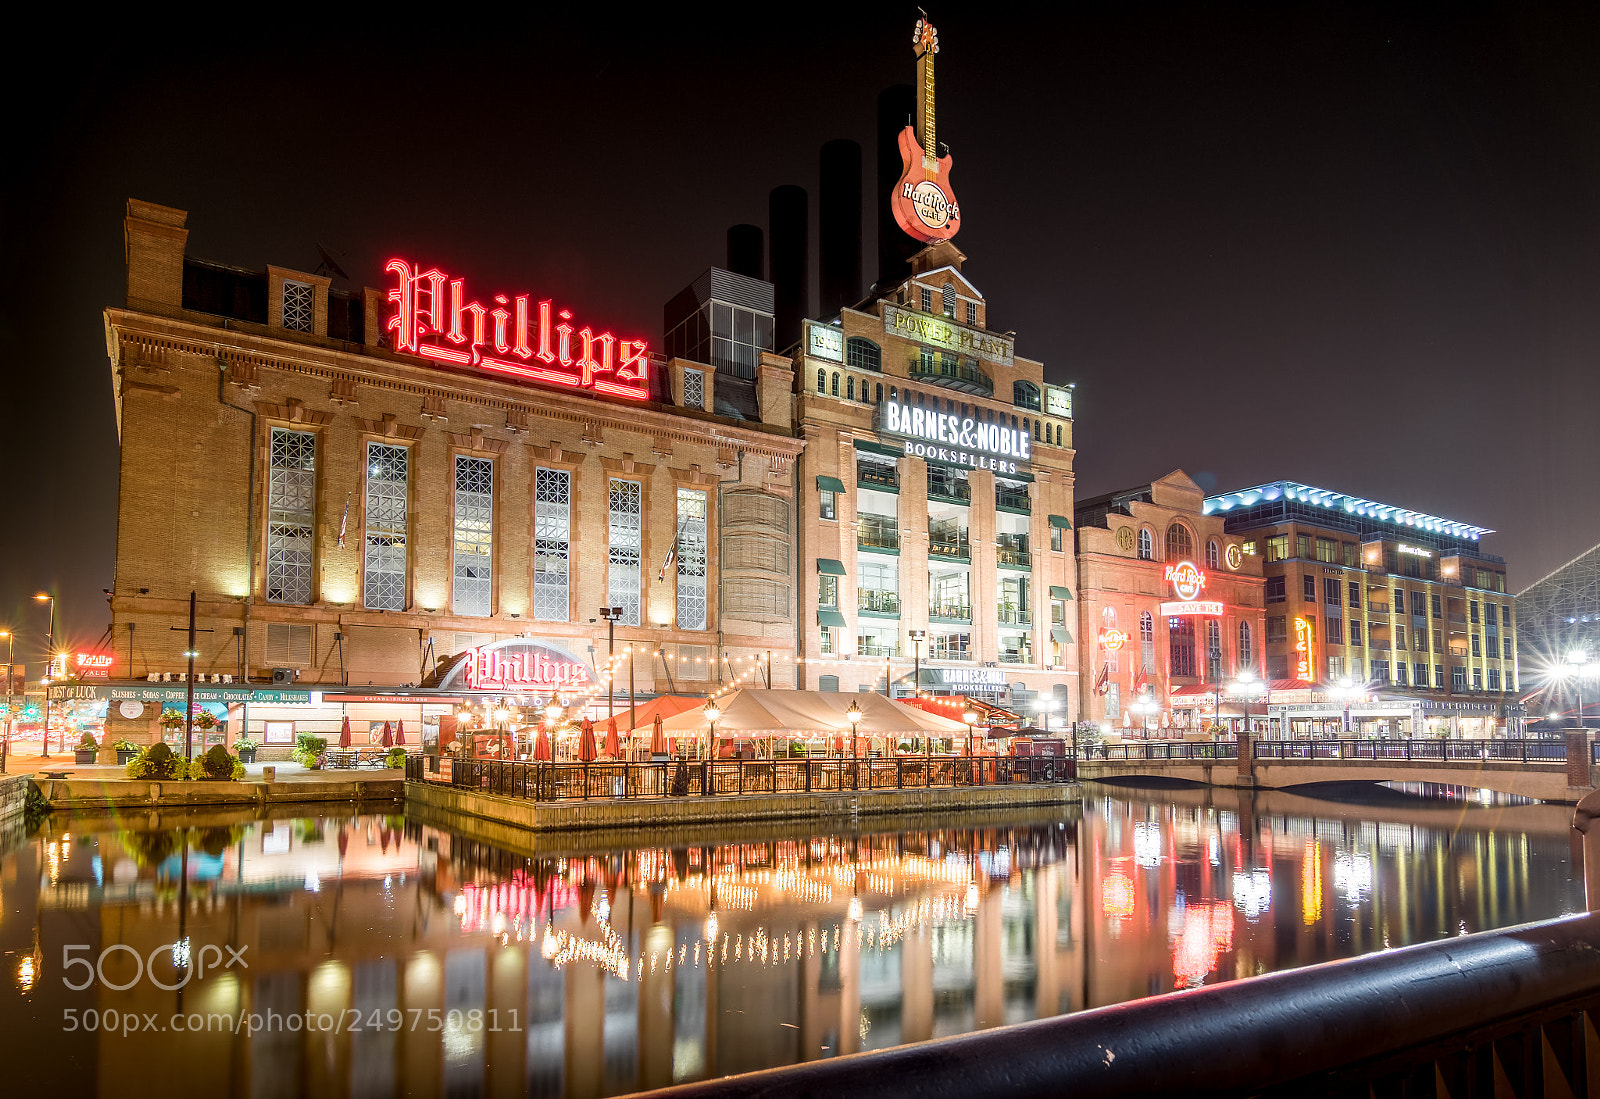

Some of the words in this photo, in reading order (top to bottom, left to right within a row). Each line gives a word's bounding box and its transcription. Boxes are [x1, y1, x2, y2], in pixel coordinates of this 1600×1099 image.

[903, 183, 933, 206] Hard
[932, 193, 960, 220] Rock
[386, 258, 649, 387] Phillips
[895, 312, 952, 344] POWER
[960, 330, 1009, 359] PLANT
[905, 441, 1017, 474] BOOKSELLERS
[1165, 565, 1187, 582] Hard
[1186, 569, 1206, 588] Rock
[1179, 604, 1202, 613] SAVE
[1205, 604, 1217, 613] THE
[466, 647, 589, 691] Phillips
[76, 685, 96, 699] LUCK
[111, 689, 136, 699] SLUSHIES
[142, 690, 160, 699] SODAS
[165, 690, 185, 699] COFFEE
[201, 691, 217, 699] CREAM
[223, 691, 252, 700] CHOCOLATES
[258, 692, 274, 700] CANDY
[280, 692, 308, 701] MILKSHAKES
[480, 696, 570, 707] SEAFOD
